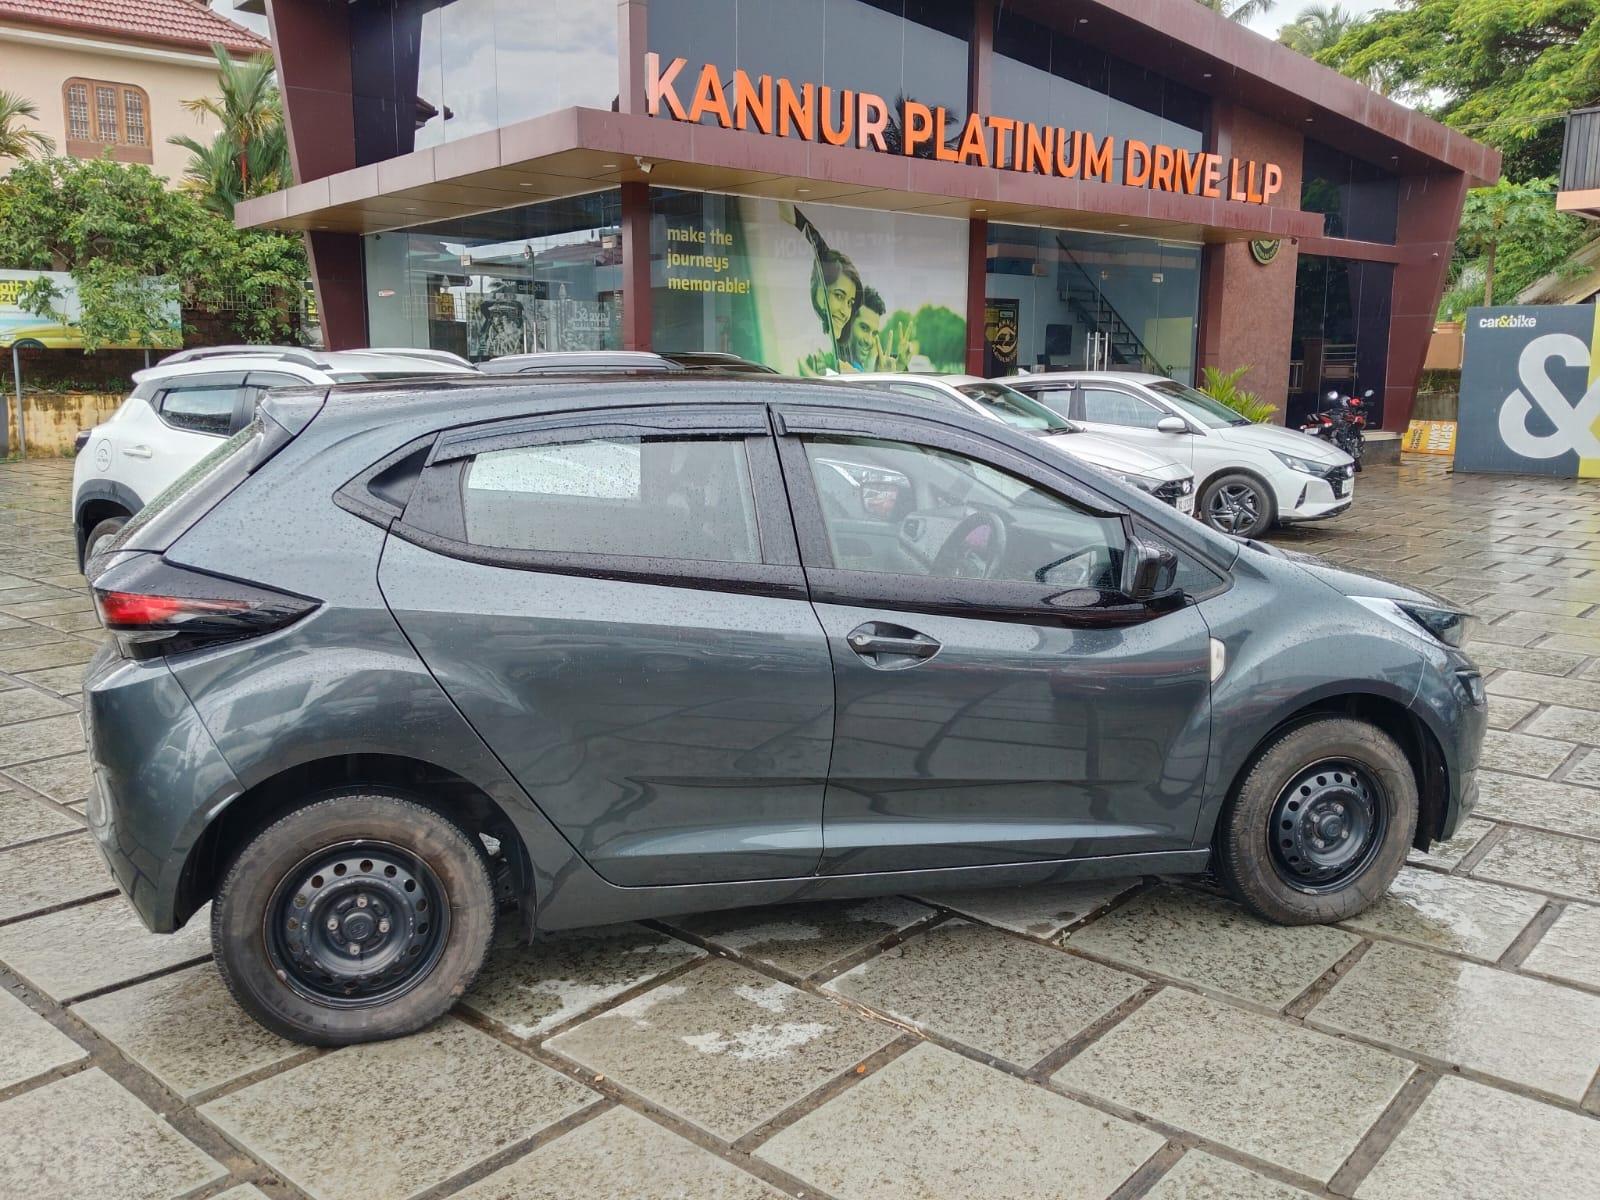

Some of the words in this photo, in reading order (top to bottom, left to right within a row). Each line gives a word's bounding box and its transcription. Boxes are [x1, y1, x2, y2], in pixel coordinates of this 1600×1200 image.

[644, 52, 888, 152] KANNUR
[902, 101, 1114, 183] PLATINUM
[1123, 138, 1223, 198] DRIVE
[1228, 157, 1283, 205] LLP
[667, 226, 706, 244] make
[710, 227, 733, 246] the
[666, 249, 729, 272] journeys
[667, 277, 750, 295] memorable!
[1479, 315, 1537, 328] car&bike
[1440, 424, 1454, 450] SPIN
